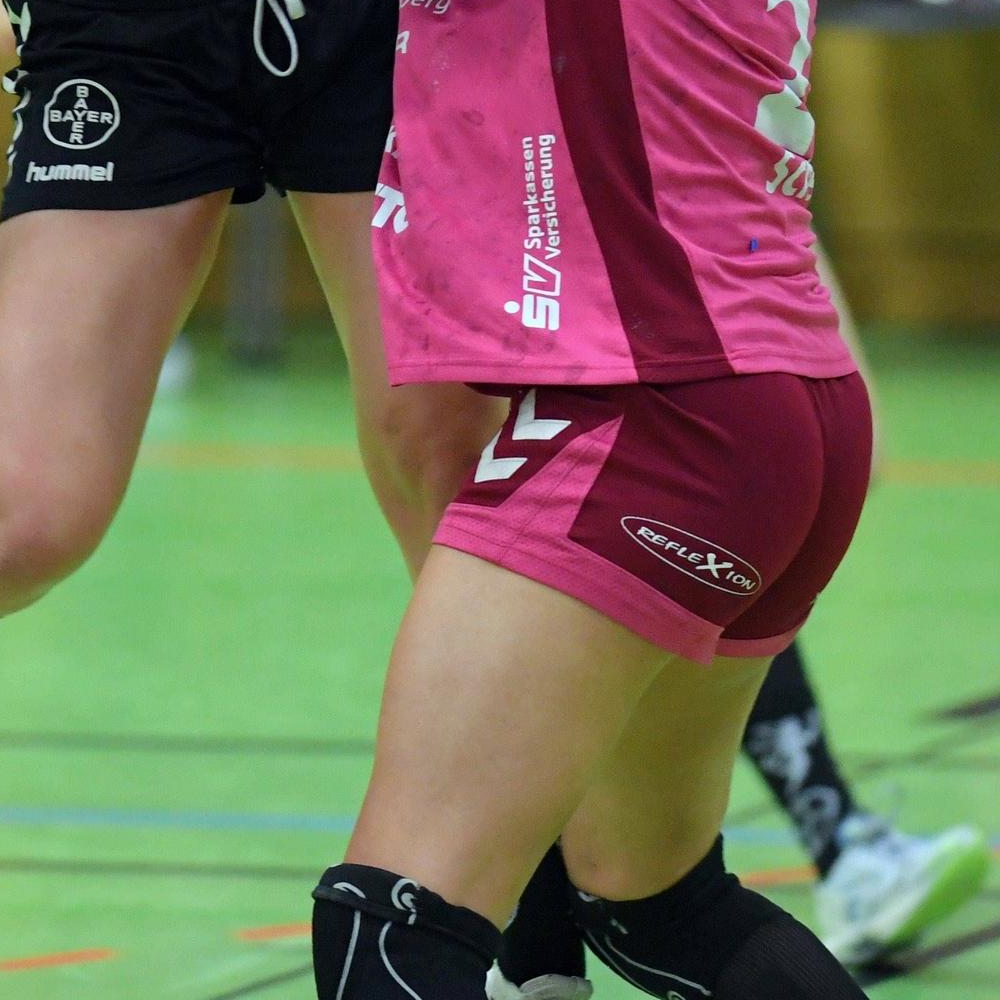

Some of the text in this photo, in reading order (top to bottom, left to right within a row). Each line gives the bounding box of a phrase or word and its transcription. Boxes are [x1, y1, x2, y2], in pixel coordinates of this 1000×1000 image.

[49, 109, 114, 125] BAYER
[69, 85, 89, 144] BAYER
[25, 161, 115, 183] hummel
[522, 136, 545, 249] Sparkassen
[538, 134, 561, 260] Versicherung
[636, 524, 757, 592] REFLEXION
